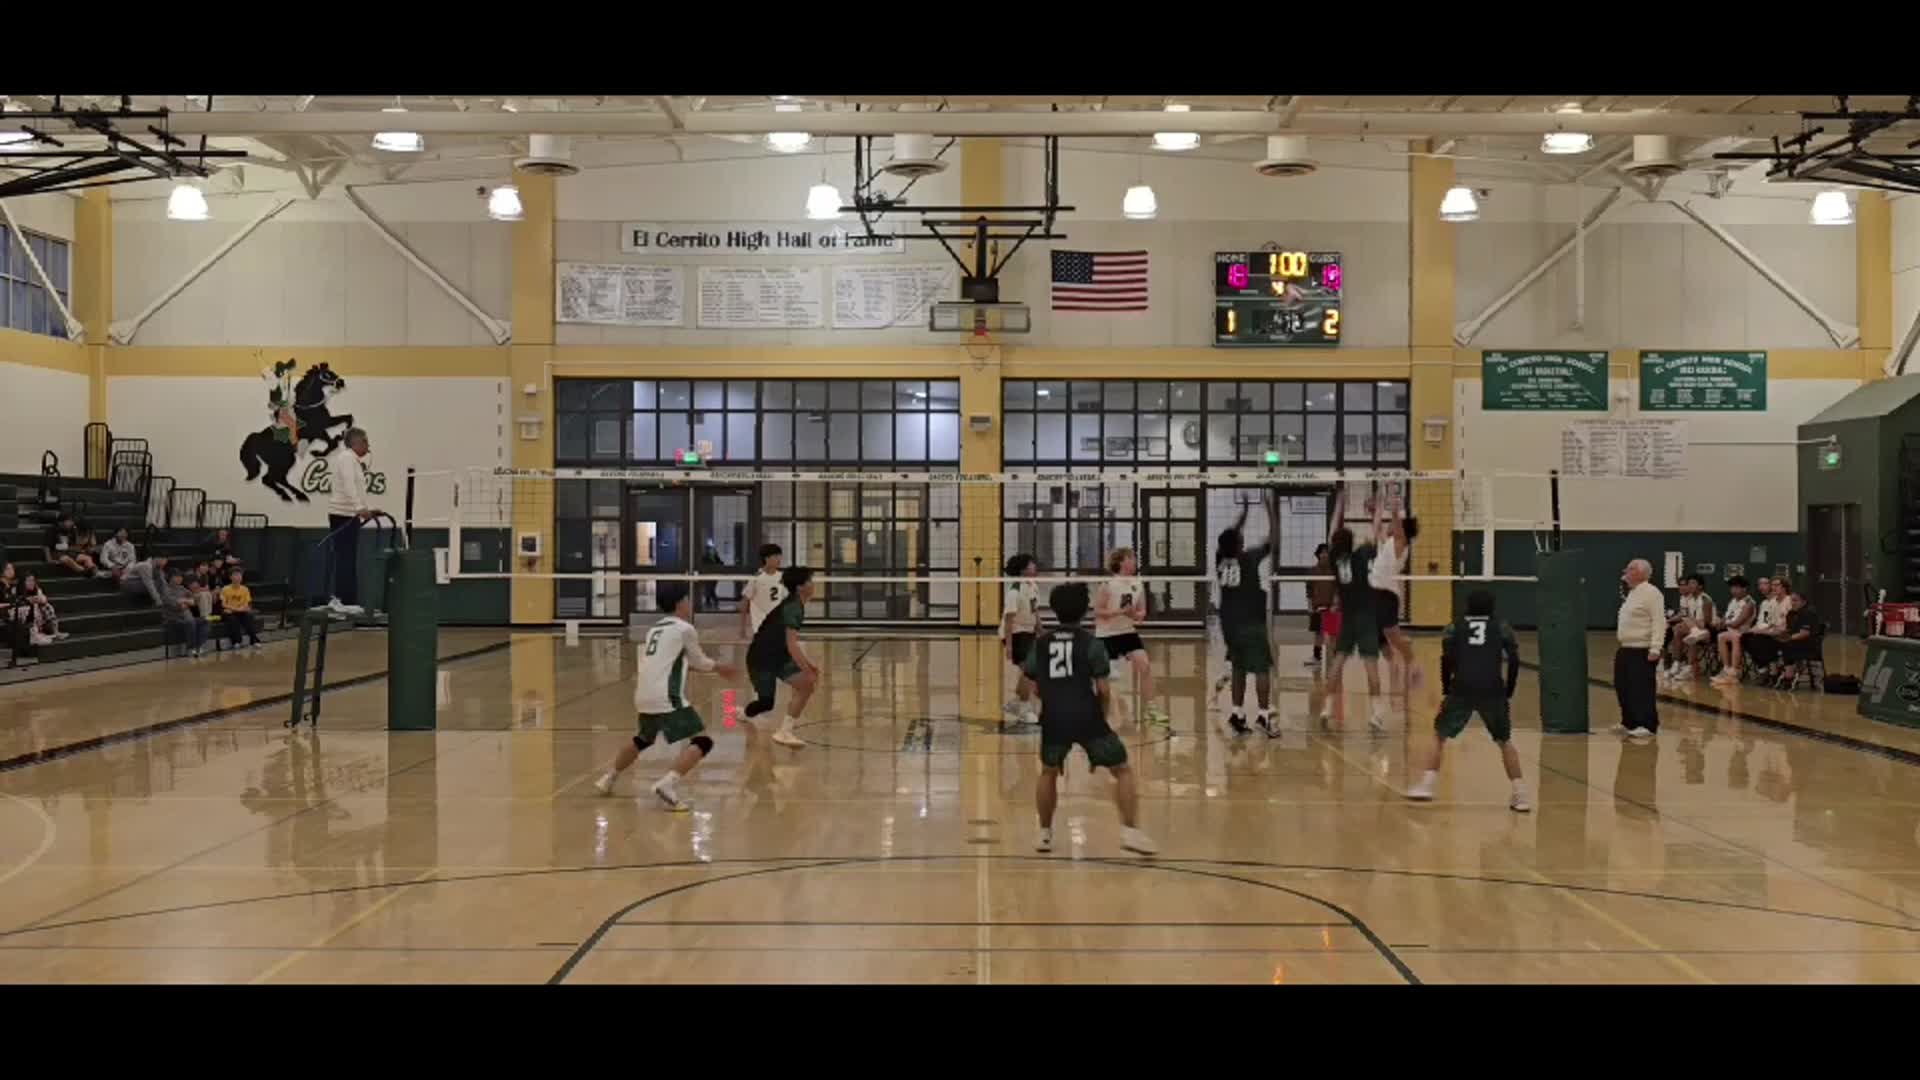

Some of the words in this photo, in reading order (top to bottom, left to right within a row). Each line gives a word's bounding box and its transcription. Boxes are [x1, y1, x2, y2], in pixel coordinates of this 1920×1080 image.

[633, 230, 648, 247] El
[656, 230, 720, 247] Cerrito
[727, 230, 769, 250] High
[777, 230, 811, 247] Hall
[1270, 252, 1307, 276] 100
[1324, 308, 1339, 334] 2
[769, 587, 778, 601] 2
[1468, 621, 1487, 646] 3
[1049, 640, 1073, 679] 21
